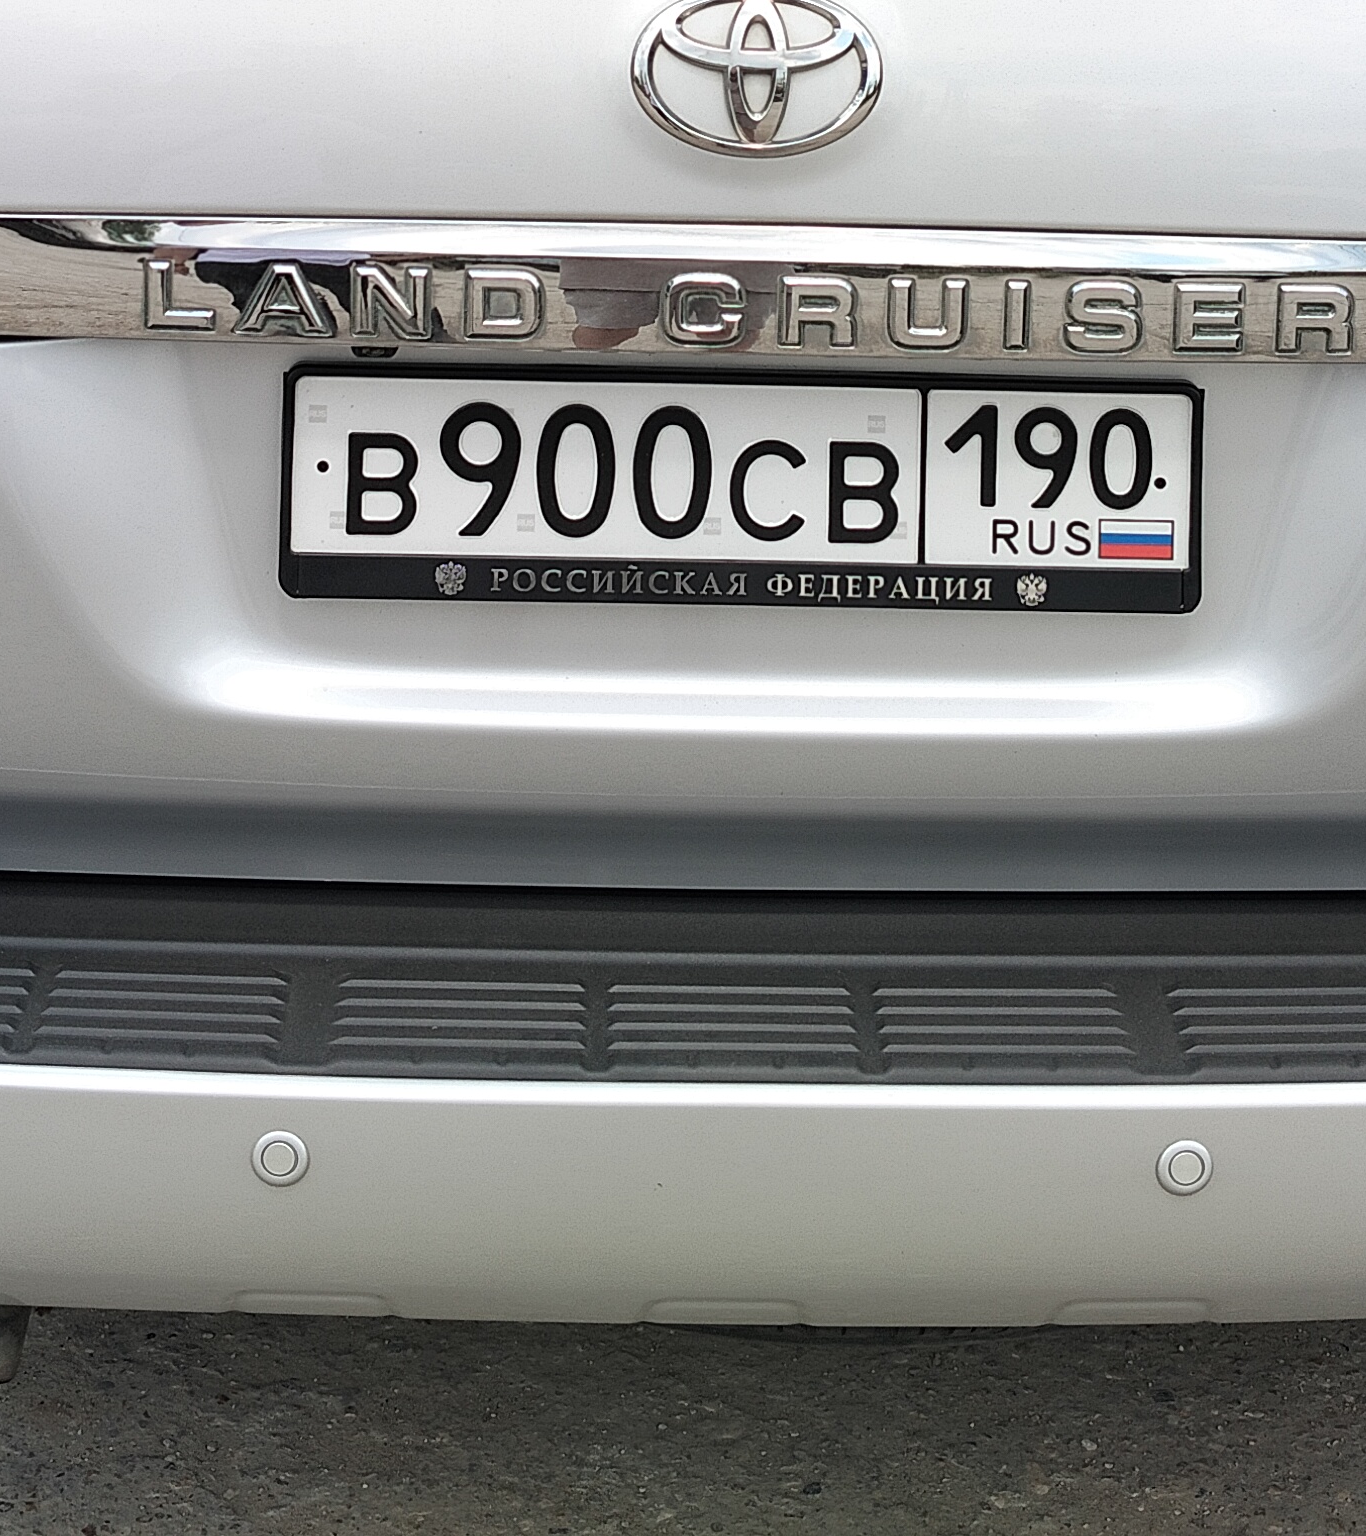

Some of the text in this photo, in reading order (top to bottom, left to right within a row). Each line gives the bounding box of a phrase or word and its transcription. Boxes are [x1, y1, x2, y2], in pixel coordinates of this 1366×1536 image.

[143, 260, 1357, 357] LAND CRUISER
[345, 401, 1153, 544] В900СВ 190
[991, 518, 1092, 556] RUS
[489, 565, 994, 605] РОССИЙСКАЯ ФЕДЕРАЦИЯ
